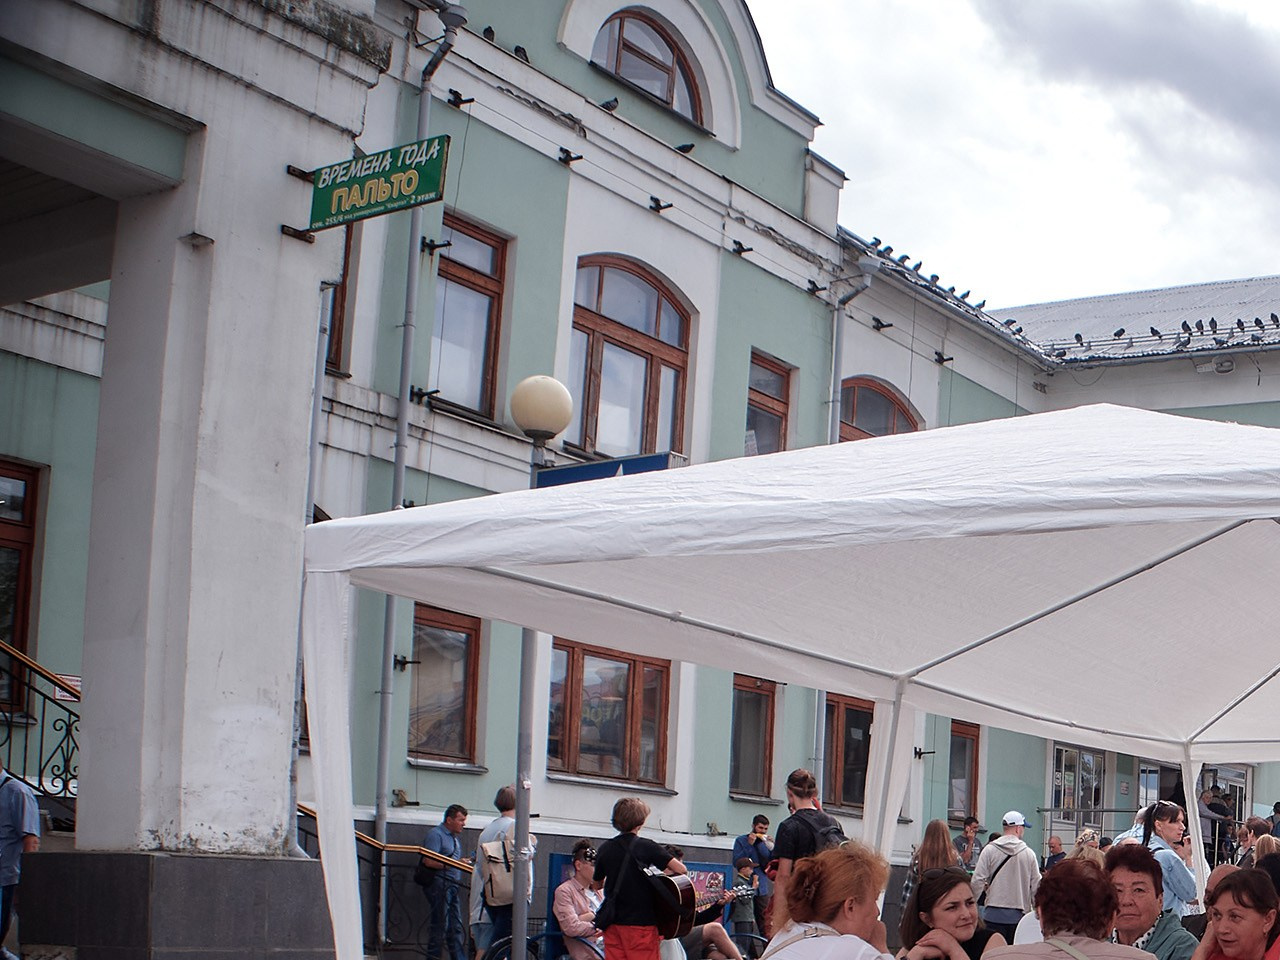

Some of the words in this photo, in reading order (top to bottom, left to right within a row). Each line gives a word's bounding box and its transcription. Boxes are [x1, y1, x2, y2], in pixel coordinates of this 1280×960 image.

[318, 152, 392, 188] ВРЕМЕНА
[397, 139, 440, 168] ГОДА
[331, 169, 419, 214] ПАЛЬТО
[410, 194, 416, 204] 2
